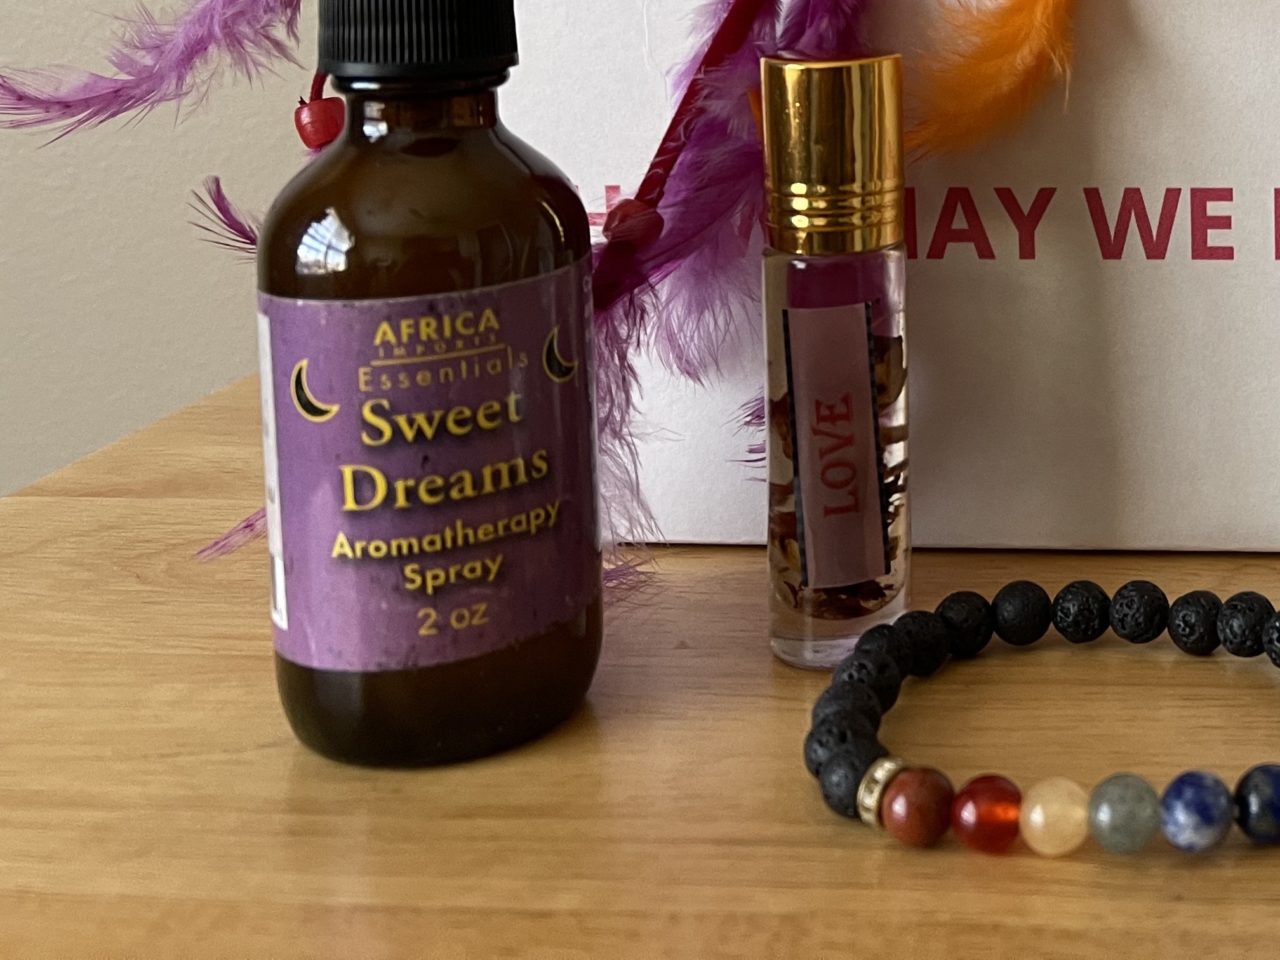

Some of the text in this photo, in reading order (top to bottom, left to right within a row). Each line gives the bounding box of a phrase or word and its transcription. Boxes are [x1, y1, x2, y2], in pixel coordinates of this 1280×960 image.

[903, 186, 1058, 260] AY
[1082, 186, 1235, 261] WE
[373, 307, 500, 347] AFRICA
[357, 345, 529, 392] Essentials
[360, 390, 524, 447] Sweet
[339, 449, 549, 513] Dreams
[810, 391, 860, 519] LOVE
[331, 499, 562, 560] Aromatherapy
[403, 554, 503, 596] Spray
[416, 607, 439, 637] 2
